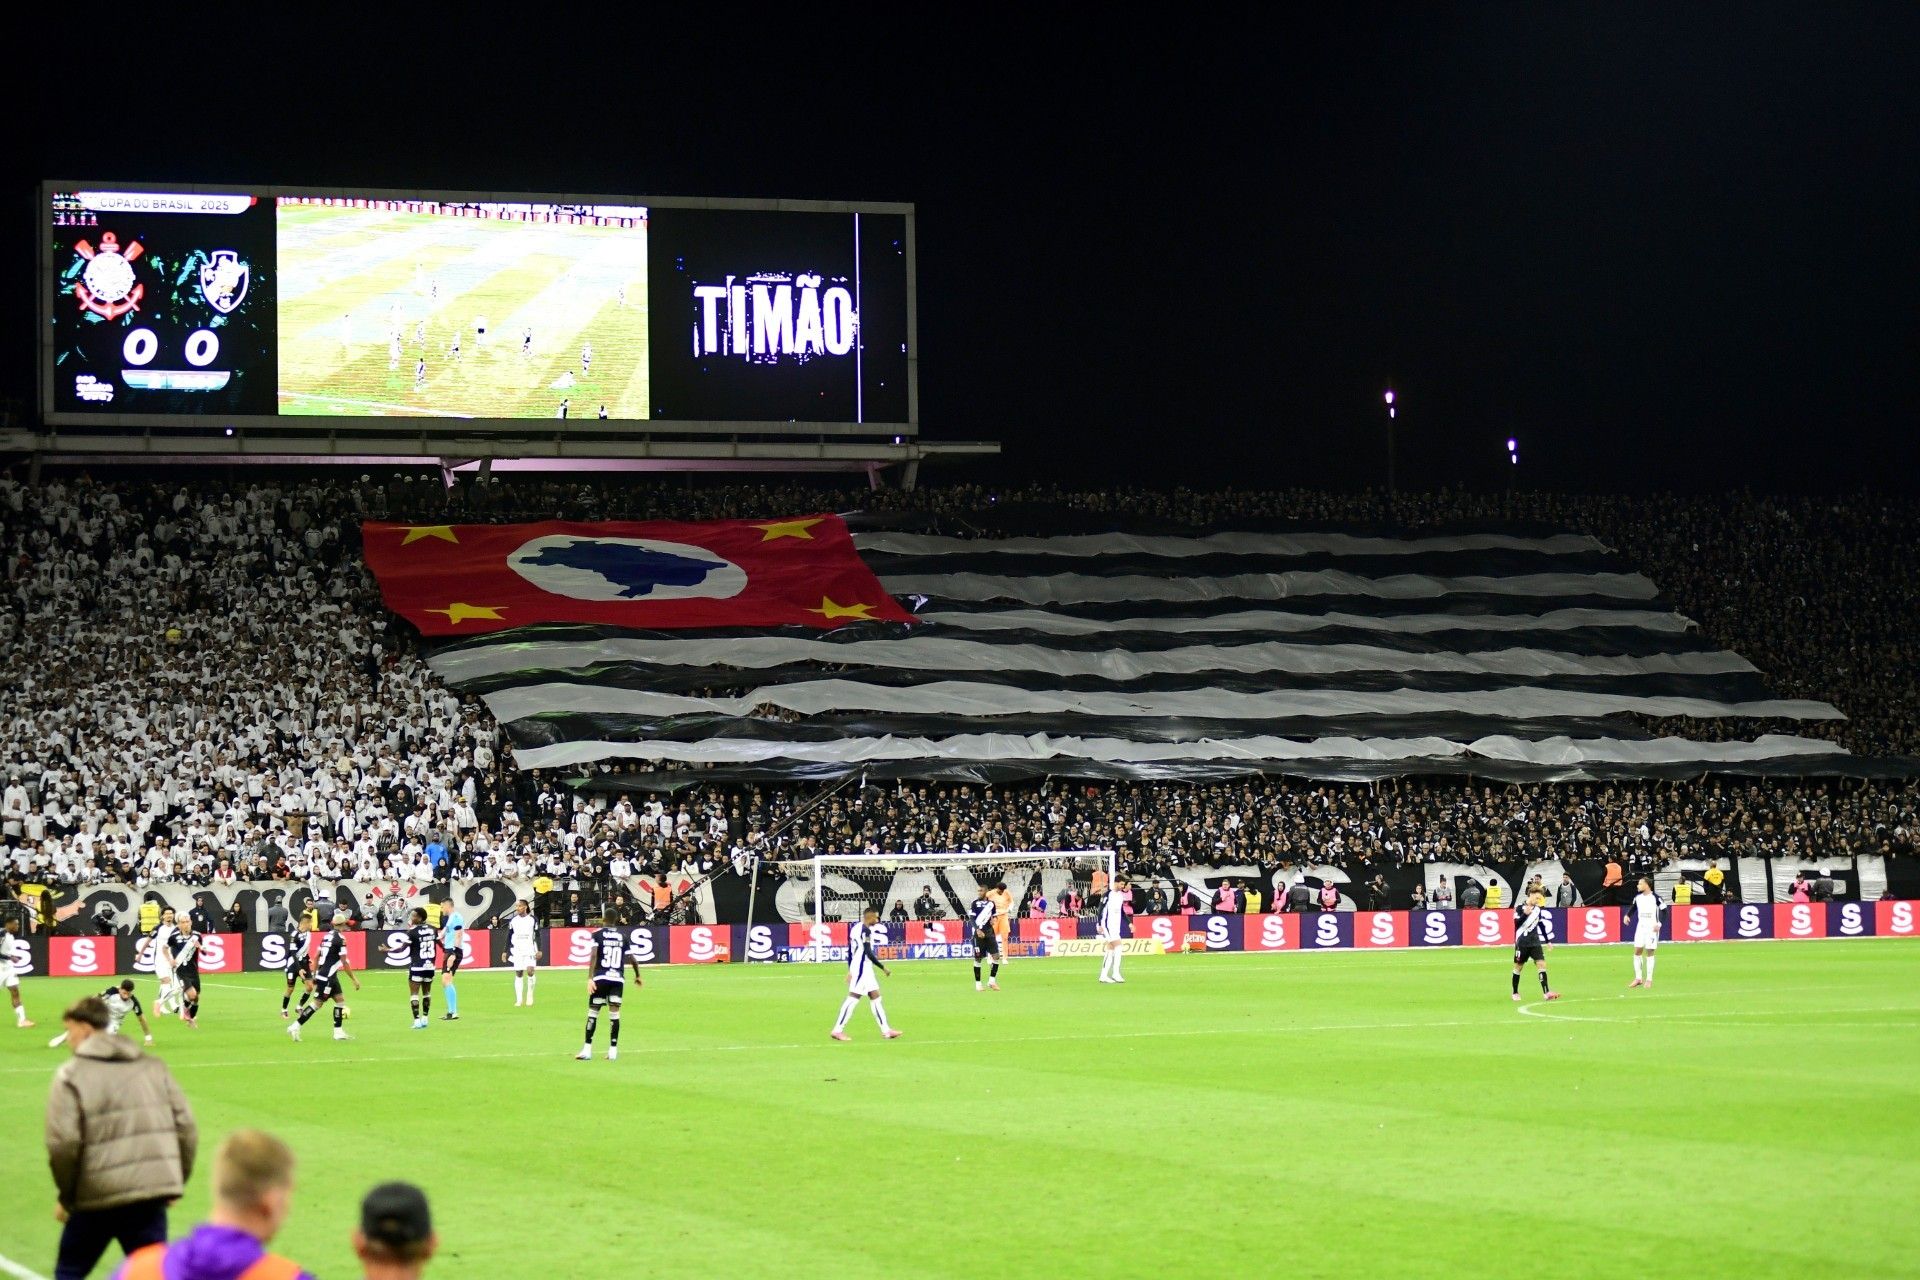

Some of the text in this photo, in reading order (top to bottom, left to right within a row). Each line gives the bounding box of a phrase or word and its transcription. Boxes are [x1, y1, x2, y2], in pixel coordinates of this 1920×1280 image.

[100, 198, 230, 211] COPA DO BRASIL 2025
[693, 274, 853, 356] TIMÃO
[123, 328, 219, 367] 0 0
[775, 864, 1358, 923] GAVIES
[1317, 914, 1339, 940] S
[1371, 912, 1395, 938] S
[1425, 912, 1447, 937] S
[1479, 910, 1499, 936] S
[1585, 908, 1606, 934] S
[1689, 906, 1708, 932] S
[1739, 905, 1760, 931] S
[1791, 904, 1811, 929] S
[1841, 903, 1861, 928] S
[1892, 901, 1913, 927] S
[630, 927, 653, 954] S
[690, 927, 713, 953] S
[750, 926, 772, 952] S
[1151, 917, 1173, 943] S
[1207, 916, 1229, 942] S
[1263, 915, 1284, 941] S
[71, 938, 96, 966] S
[198, 935, 224, 964] S
[262, 934, 286, 962] S
[419, 940, 436, 960] 23
[571, 929, 597, 956] S
[877, 944, 908, 959] BET
[914, 944, 950, 958] VIVA
[1057, 938, 1152, 956] quartolit
[601, 946, 622, 968] 30
